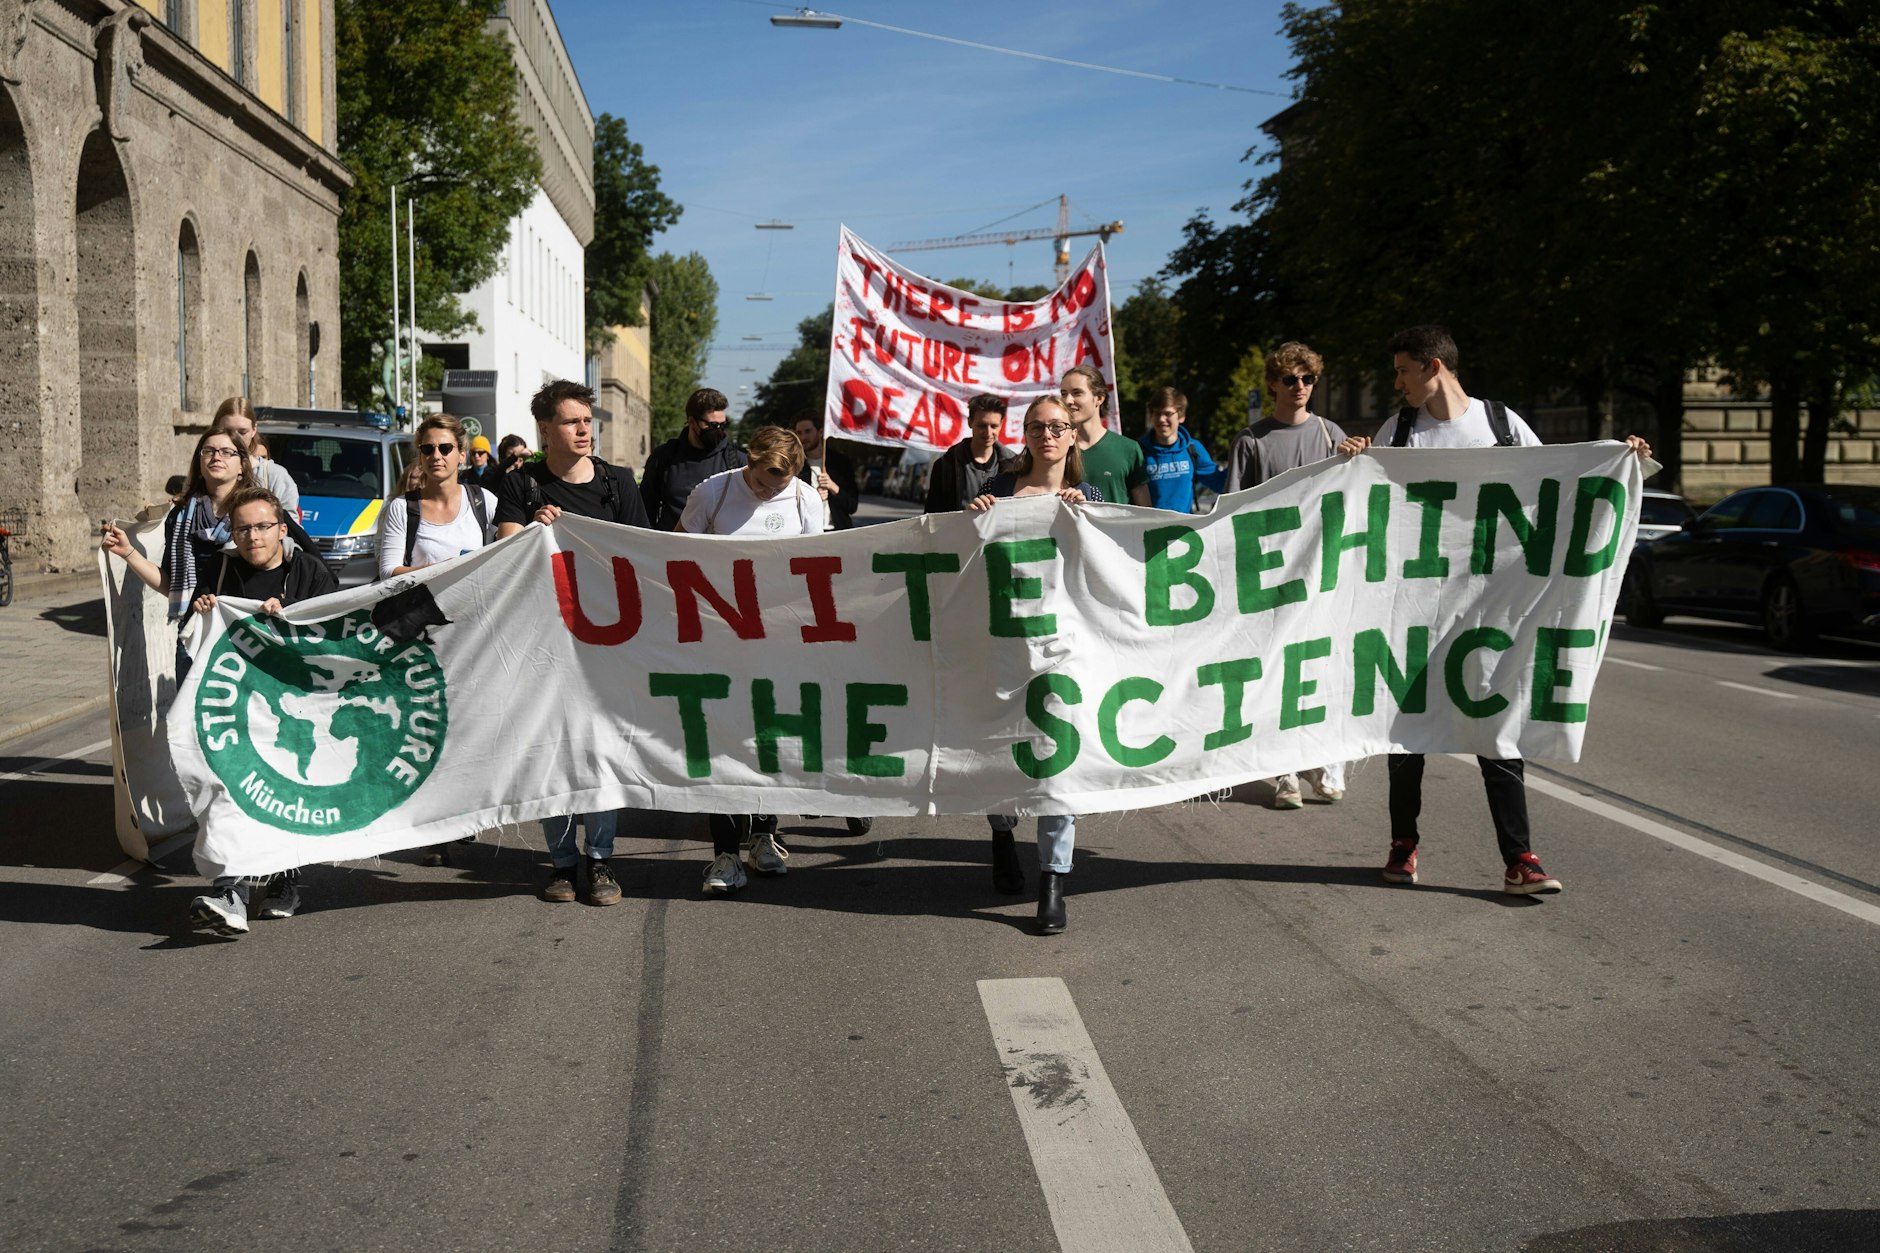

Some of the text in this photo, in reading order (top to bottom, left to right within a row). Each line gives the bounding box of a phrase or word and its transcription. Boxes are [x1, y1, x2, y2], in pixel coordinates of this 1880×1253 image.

[852, 253, 1097, 333] THERE IS NO
[850, 317, 1102, 384] FUTURE ON A
[839, 379, 963, 448] DEAD
[551, 477, 1627, 646] UNITE BEHIND
[341, 617, 395, 655] FOR
[385, 646, 440, 787] FUTURE
[649, 672, 908, 778] THE
[239, 771, 341, 826] München
